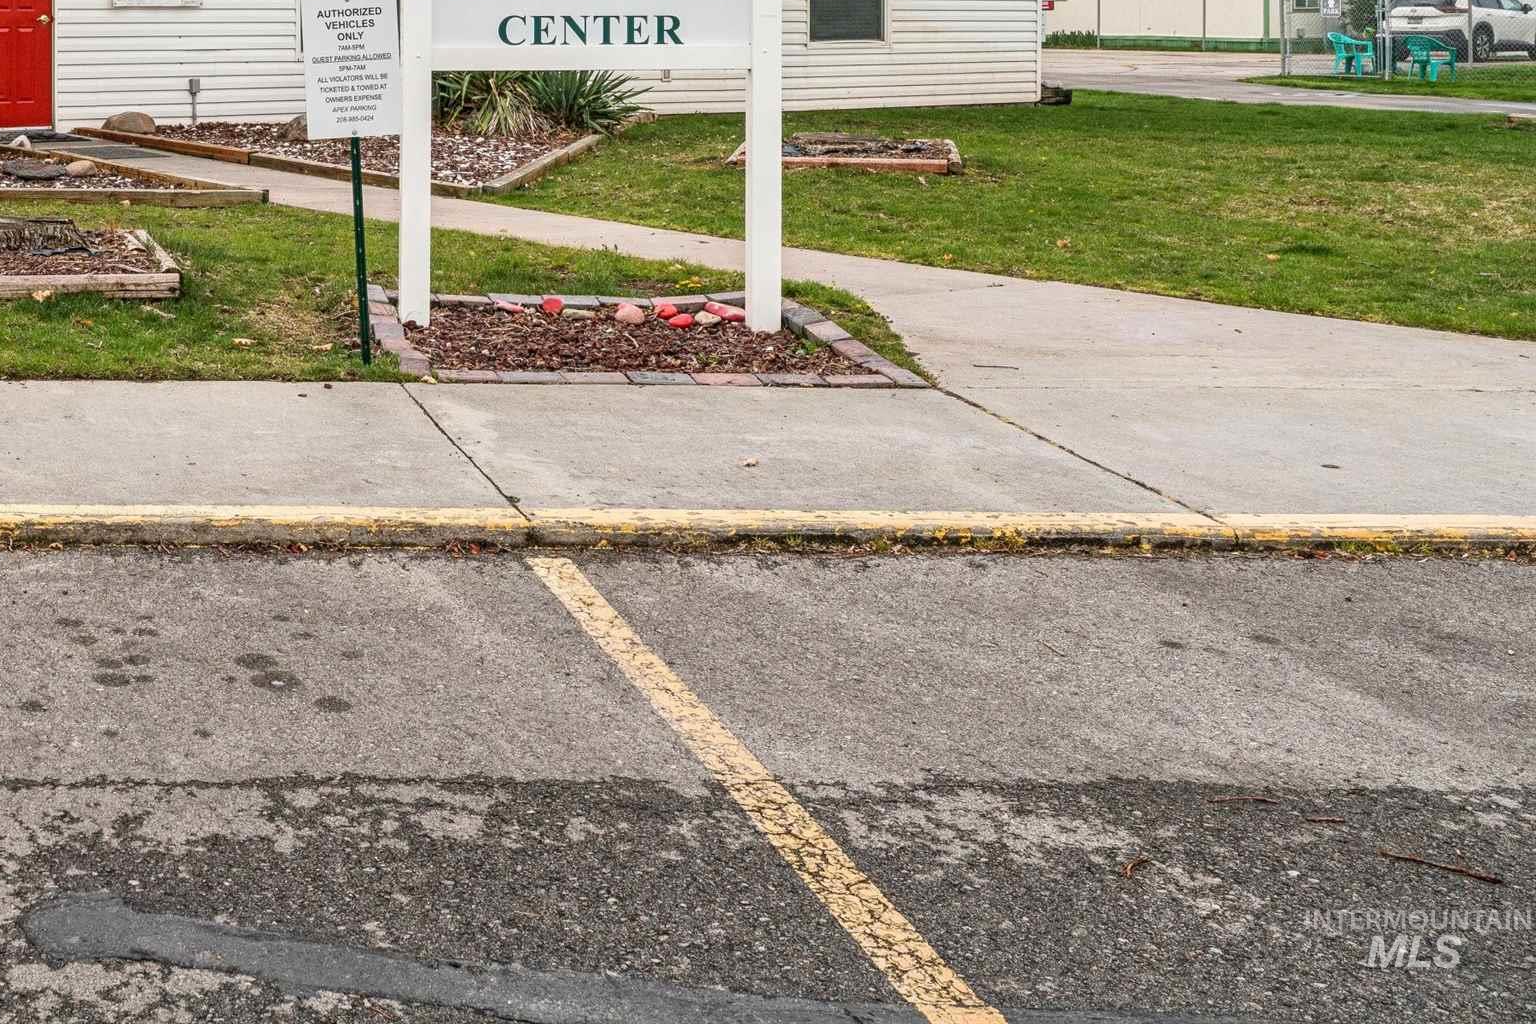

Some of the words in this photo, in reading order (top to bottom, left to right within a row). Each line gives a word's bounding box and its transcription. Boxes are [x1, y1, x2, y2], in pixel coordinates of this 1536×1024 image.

[317, 6, 382, 19] AUTHORIZED
[325, 18, 376, 30] VEHICLES
[337, 31, 364, 41] ONLY
[498, 14, 684, 47] CENTER
[334, 54, 361, 63] PARKING
[361, 52, 392, 61] ALLOWED
[329, 74, 364, 83] VIOLATORS
[365, 73, 379, 81] WILL
[325, 95, 352, 103] OWNERS
[353, 94, 382, 102] EXPENSE
